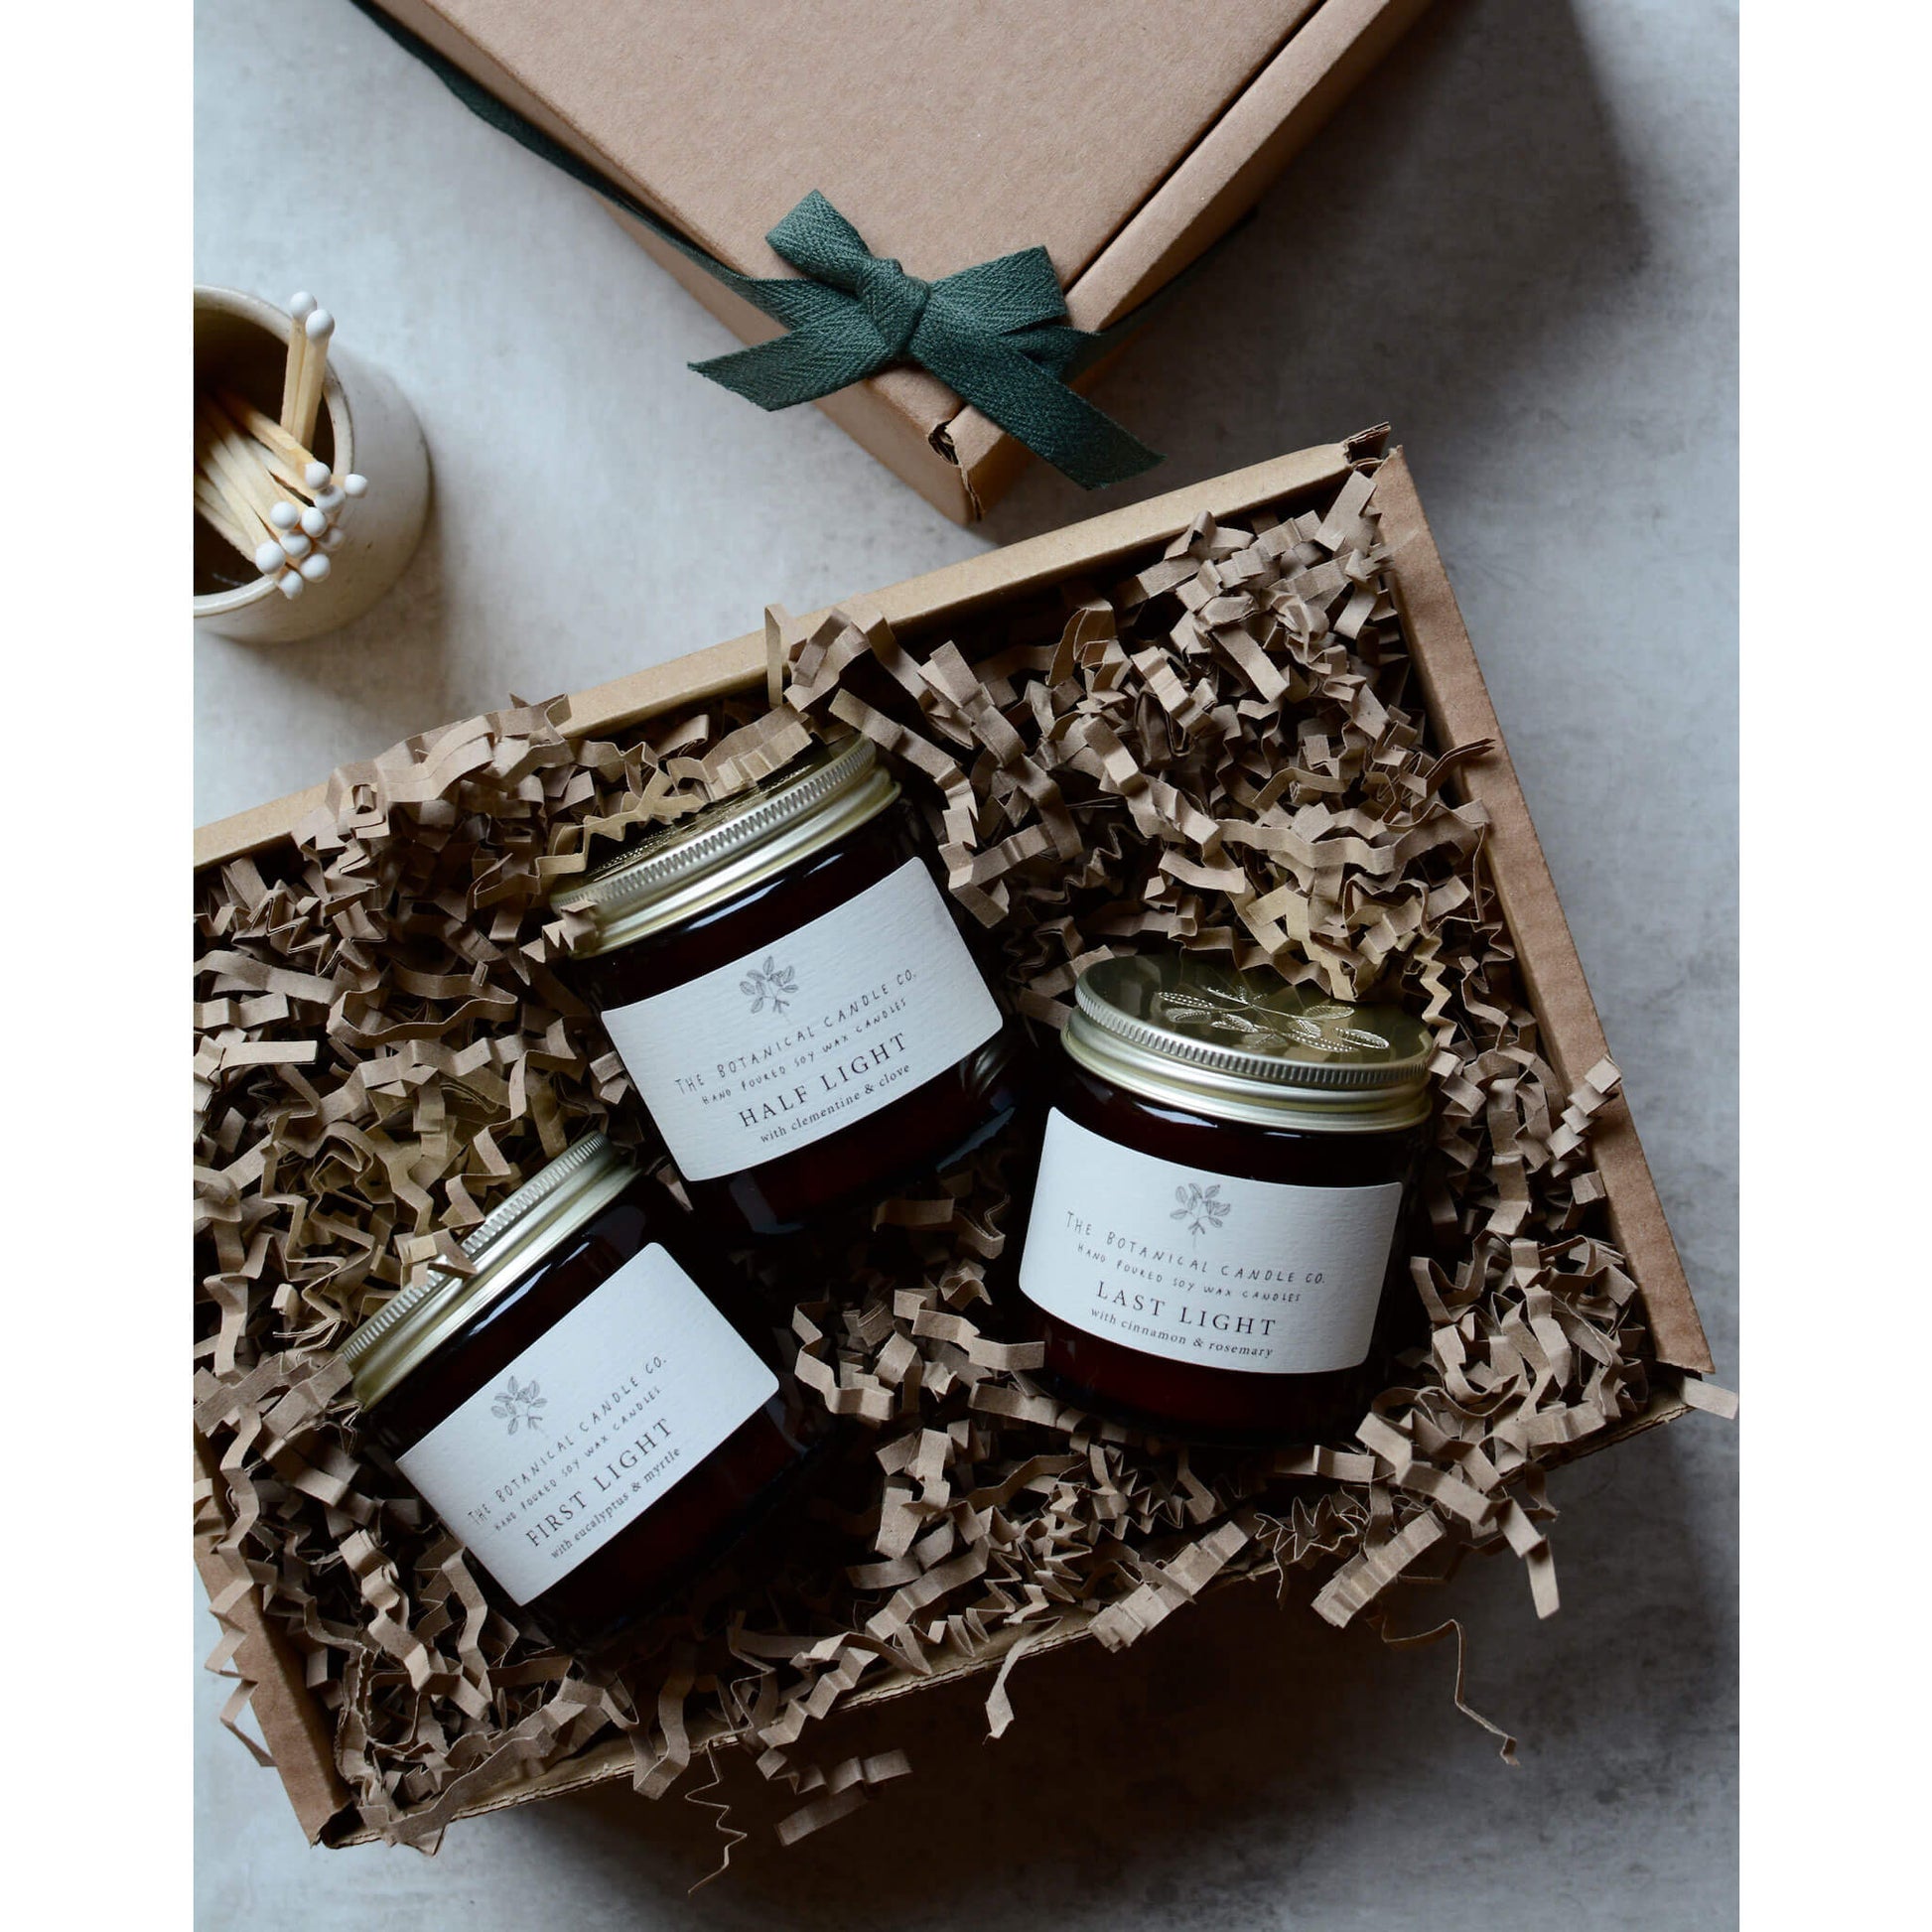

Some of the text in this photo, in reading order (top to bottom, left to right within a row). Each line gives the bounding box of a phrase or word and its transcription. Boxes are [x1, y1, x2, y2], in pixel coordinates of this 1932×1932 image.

[675, 969, 916, 1095] THE BOTANICAL CANDLE CO.
[702, 1089, 732, 1105] HAND
[794, 1052, 815, 1067] SOY
[822, 1036, 848, 1053] WAX
[856, 998, 906, 1033] CANDLES
[740, 1033, 906, 1127] HALF LIGHT
[760, 1064, 910, 1143] with clementine & clove
[1066, 1211, 1325, 1284] THE BOTANICAL CANDLE CO.
[1078, 1244, 1106, 1263] HAND
[1173, 1278, 1194, 1291] SOY
[1203, 1287, 1231, 1296] WAX
[1242, 1291, 1301, 1302] CANDLES
[1092, 1309, 1273, 1358] with cinnamon & rosemary
[1097, 1280, 1276, 1335] LAST LIGHT
[468, 1356, 666, 1525] THE BOTANICAL CANDLE CO.
[496, 1513, 516, 1531] HAND
[562, 1459, 580, 1476] SOY
[585, 1436, 608, 1457] WAX
[614, 1387, 661, 1431] CANDLES
[526, 1419, 671, 1547] FIRST LIGHT
[551, 1448, 680, 1558] with eucalyptus & myrtle
